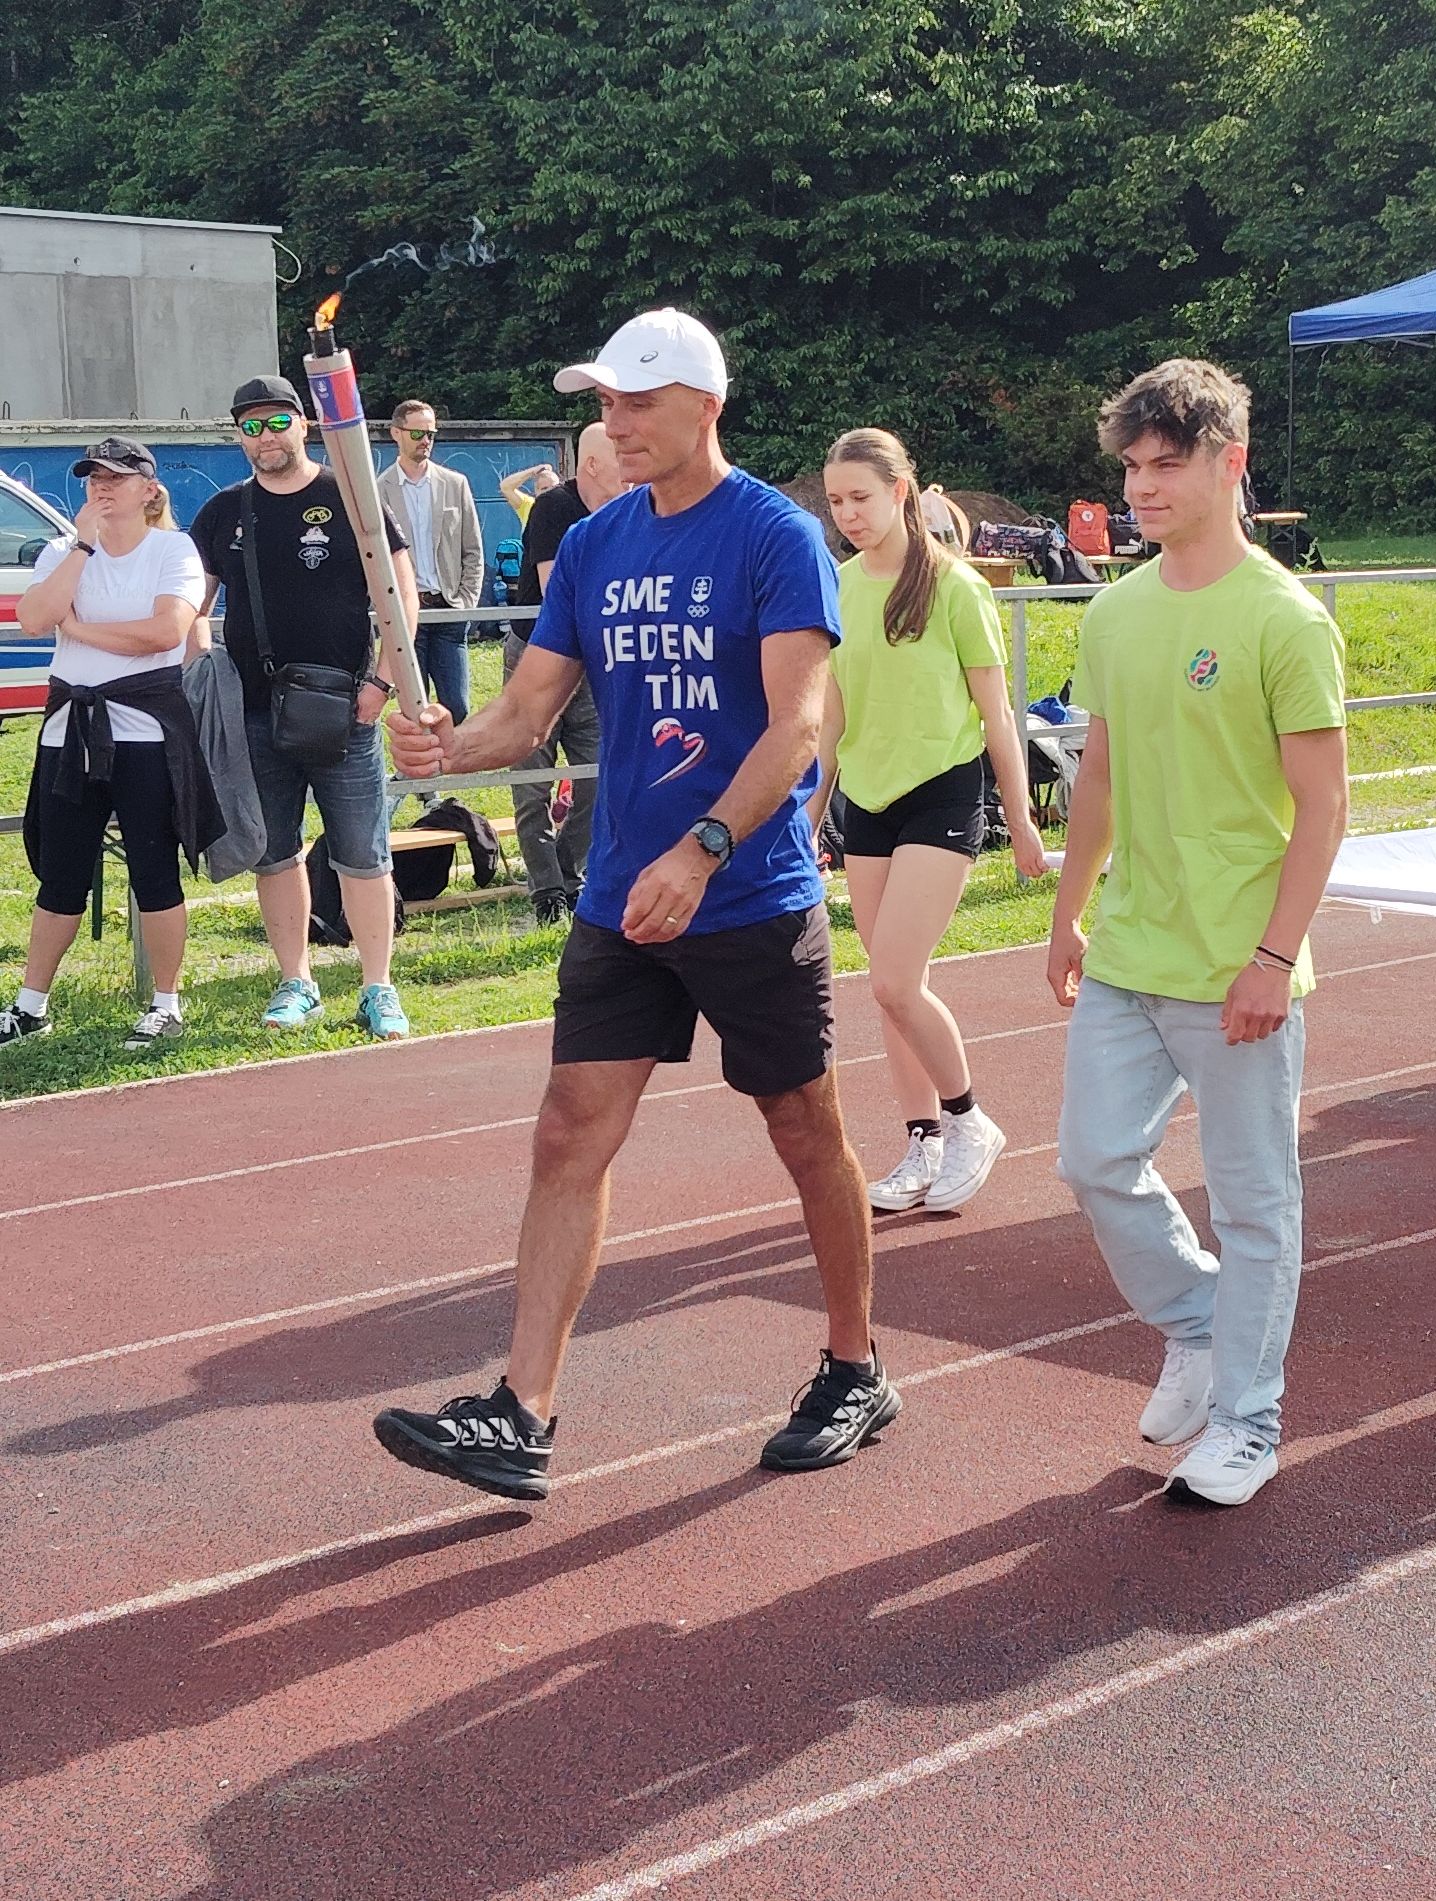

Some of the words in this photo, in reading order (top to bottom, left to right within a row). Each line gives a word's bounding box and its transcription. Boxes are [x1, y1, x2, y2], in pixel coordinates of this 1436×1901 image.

[601, 575, 674, 616] SME
[603, 624, 714, 673] JEDEN
[645, 663, 719, 711] TÍM
